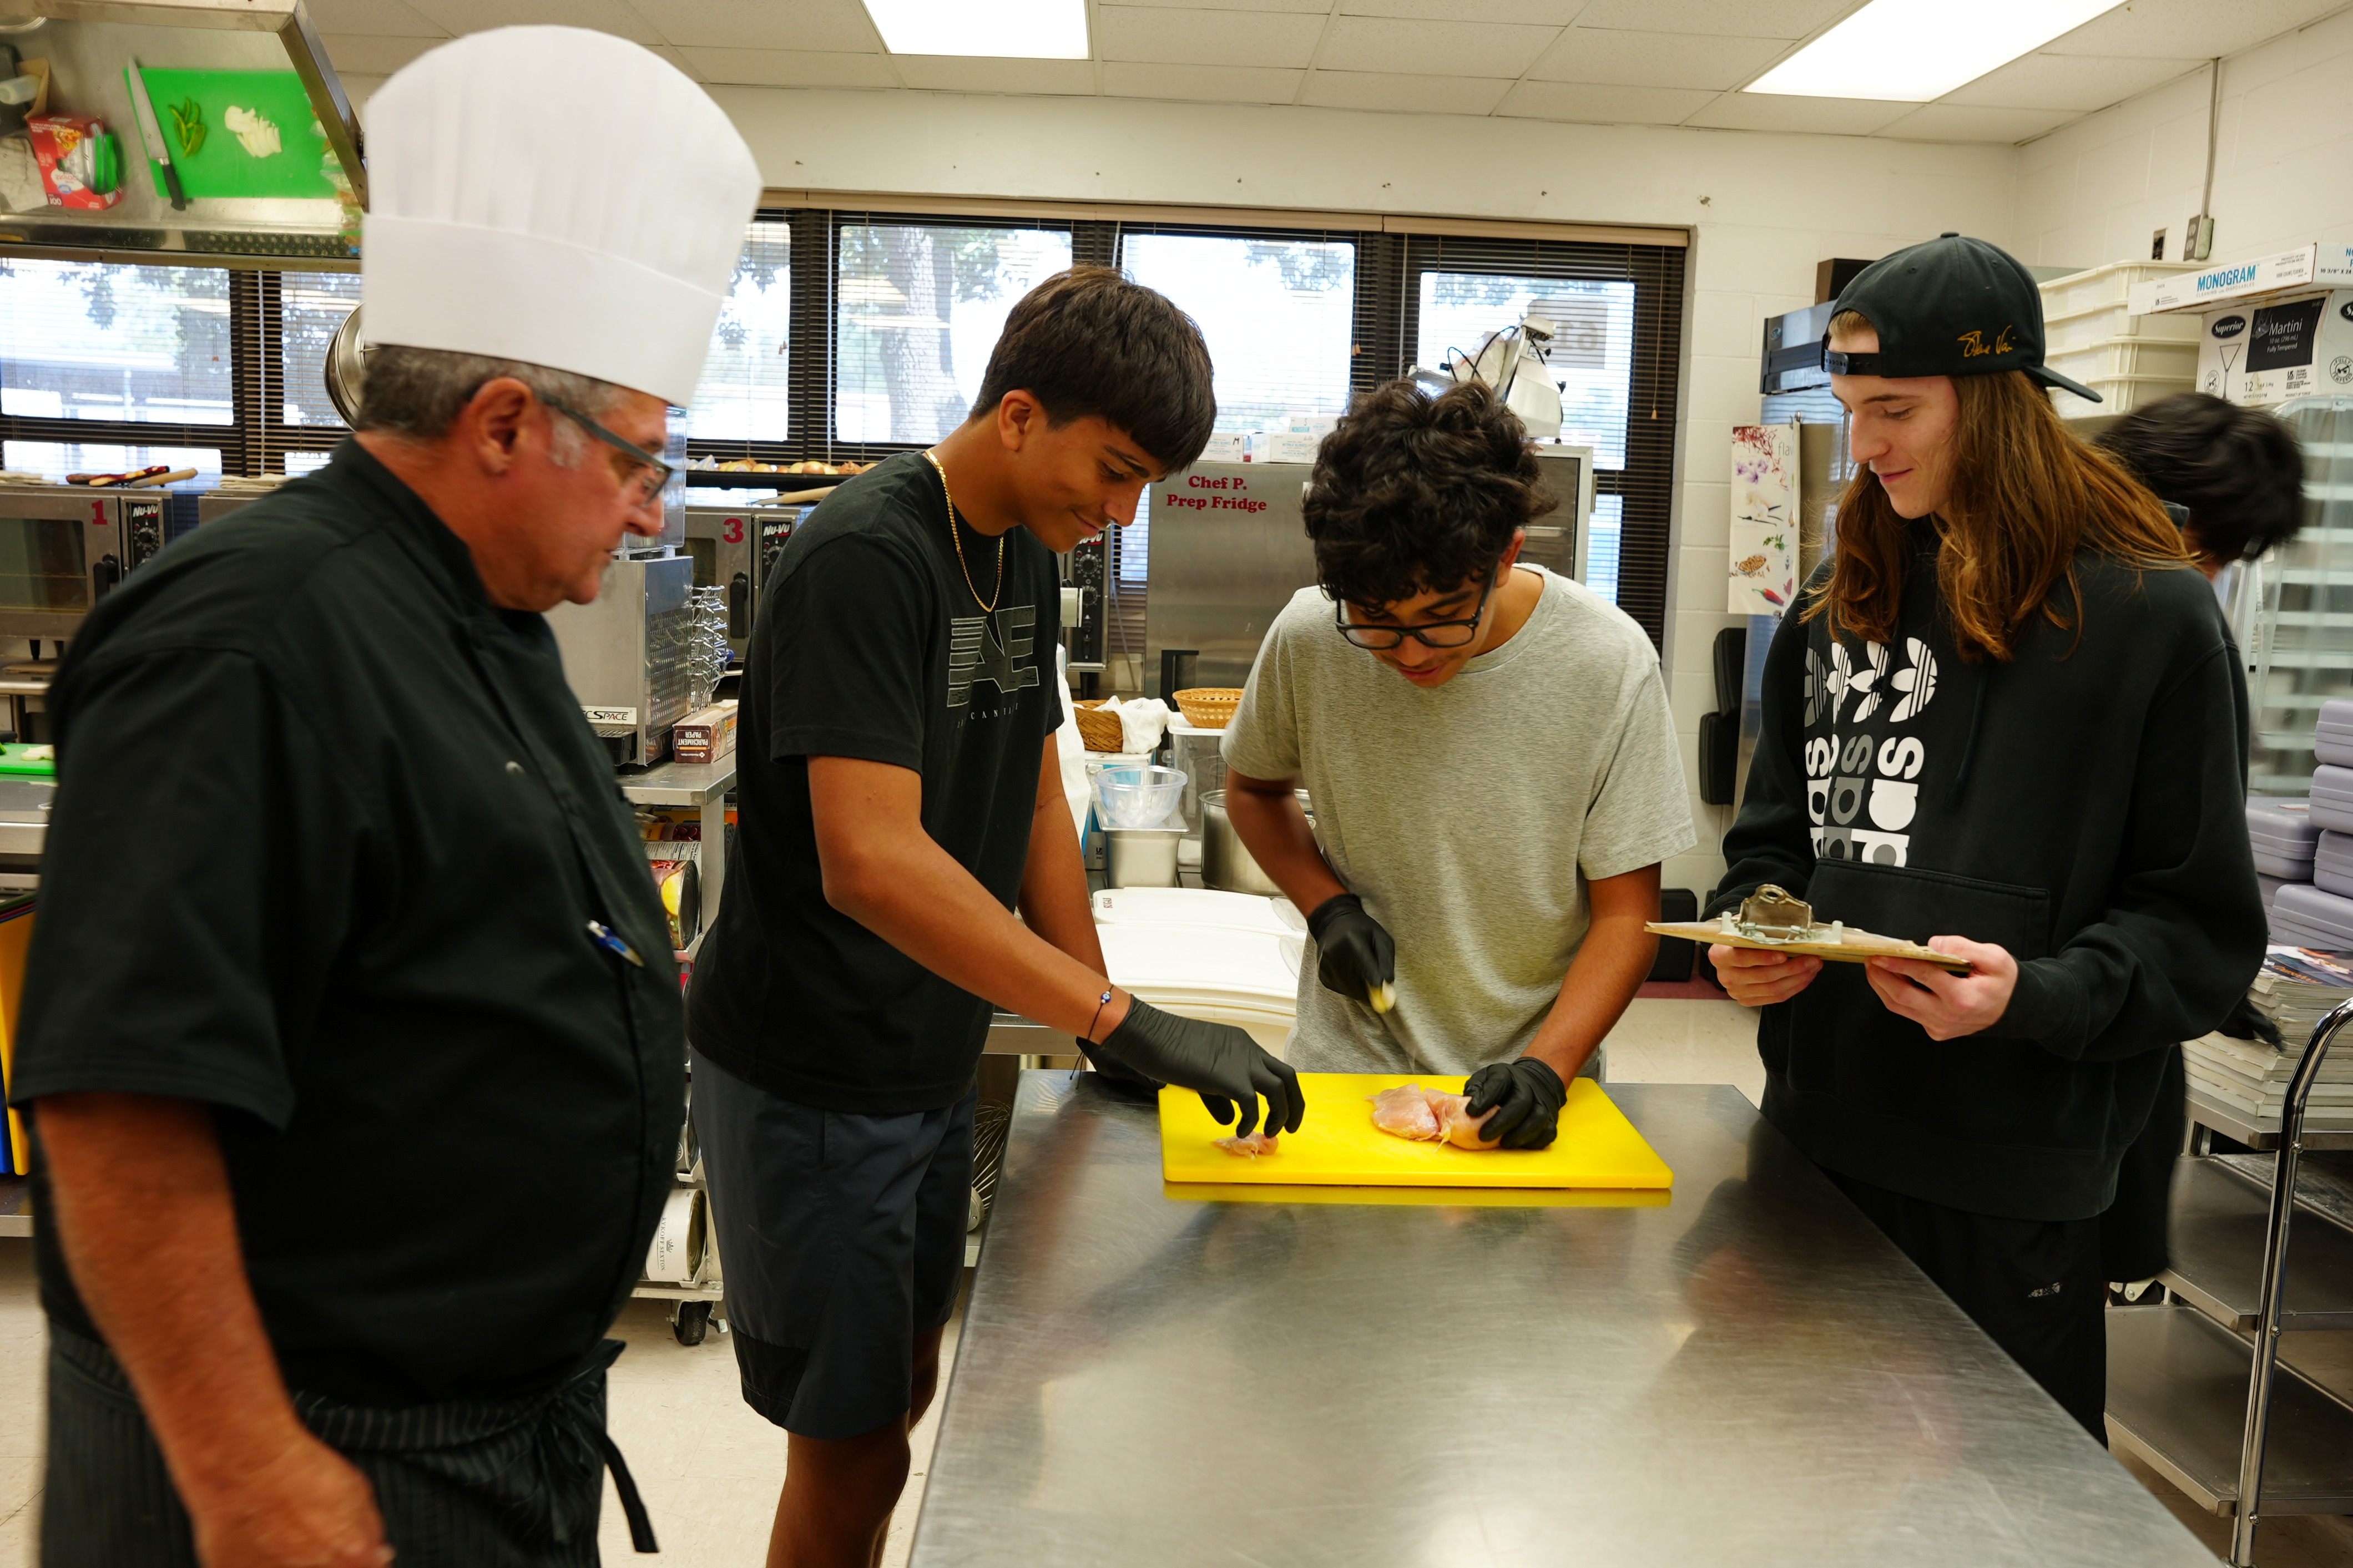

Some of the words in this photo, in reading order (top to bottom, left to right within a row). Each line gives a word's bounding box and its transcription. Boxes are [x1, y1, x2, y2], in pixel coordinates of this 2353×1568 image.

[2197, 265, 2256, 292] MONOGRAM
[2214, 320, 2244, 336] Superior
[2269, 317, 2303, 336] Martini
[2245, 381, 2253, 392] 12
[1188, 476, 1228, 489] Chef
[1233, 478, 1248, 490] P.
[92, 500, 108, 525] 1
[1167, 494, 1207, 510] Prep
[1211, 496, 1267, 513] Fridge
[723, 518, 744, 544] 3
